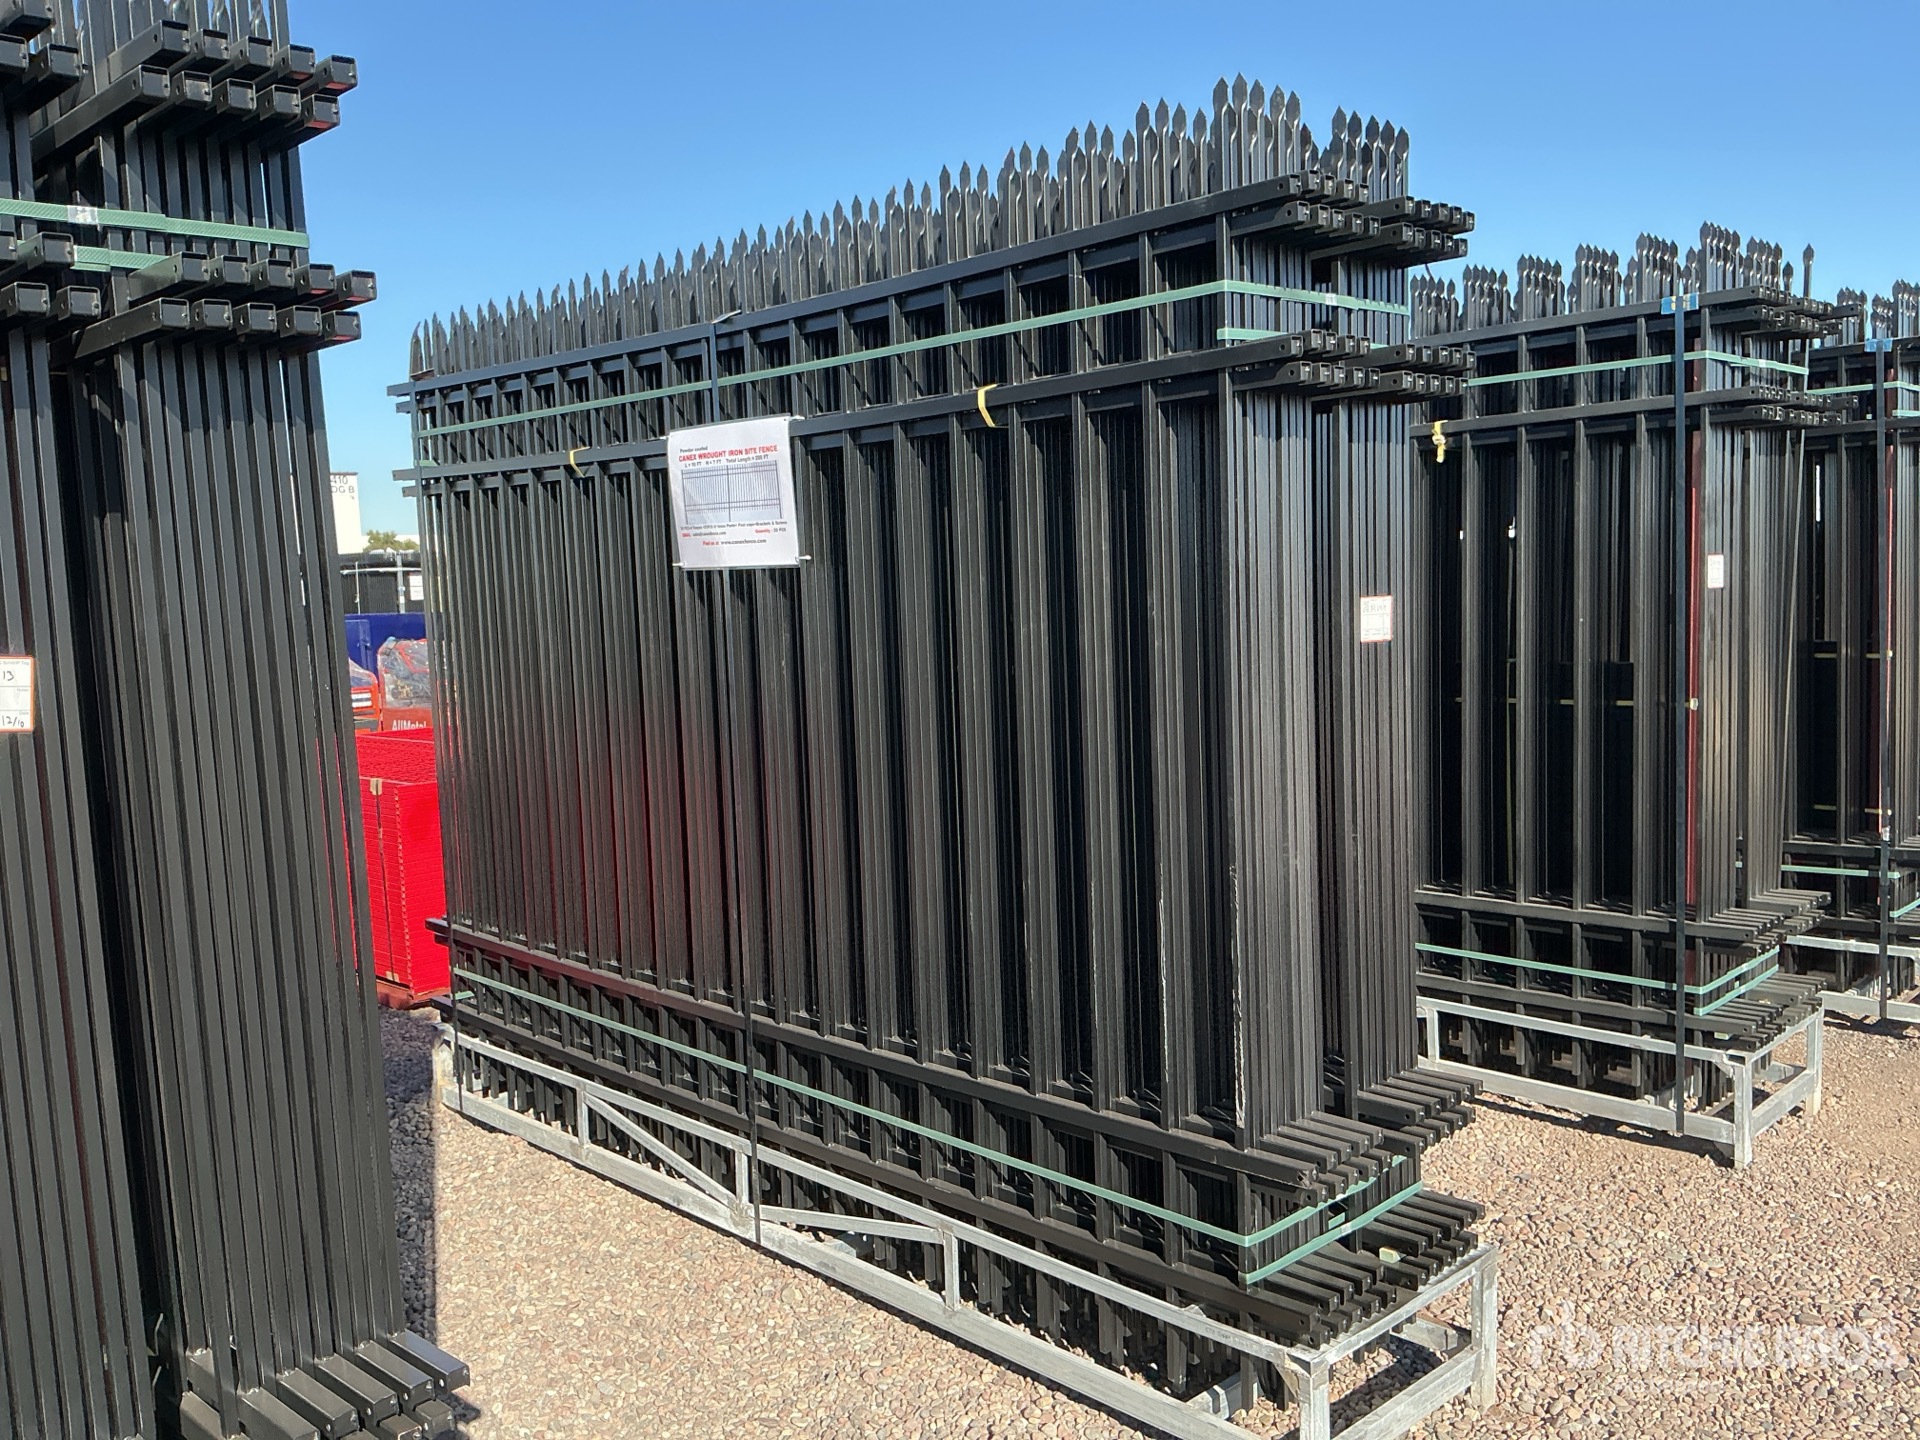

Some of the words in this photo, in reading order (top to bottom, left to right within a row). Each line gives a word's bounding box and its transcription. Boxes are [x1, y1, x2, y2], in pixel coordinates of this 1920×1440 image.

[679, 454, 696, 462] CANEX
[698, 450, 726, 460] WROUGHT
[728, 448, 743, 456] IRON
[759, 444, 778, 452] FENCE
[348, 486, 354, 494] B
